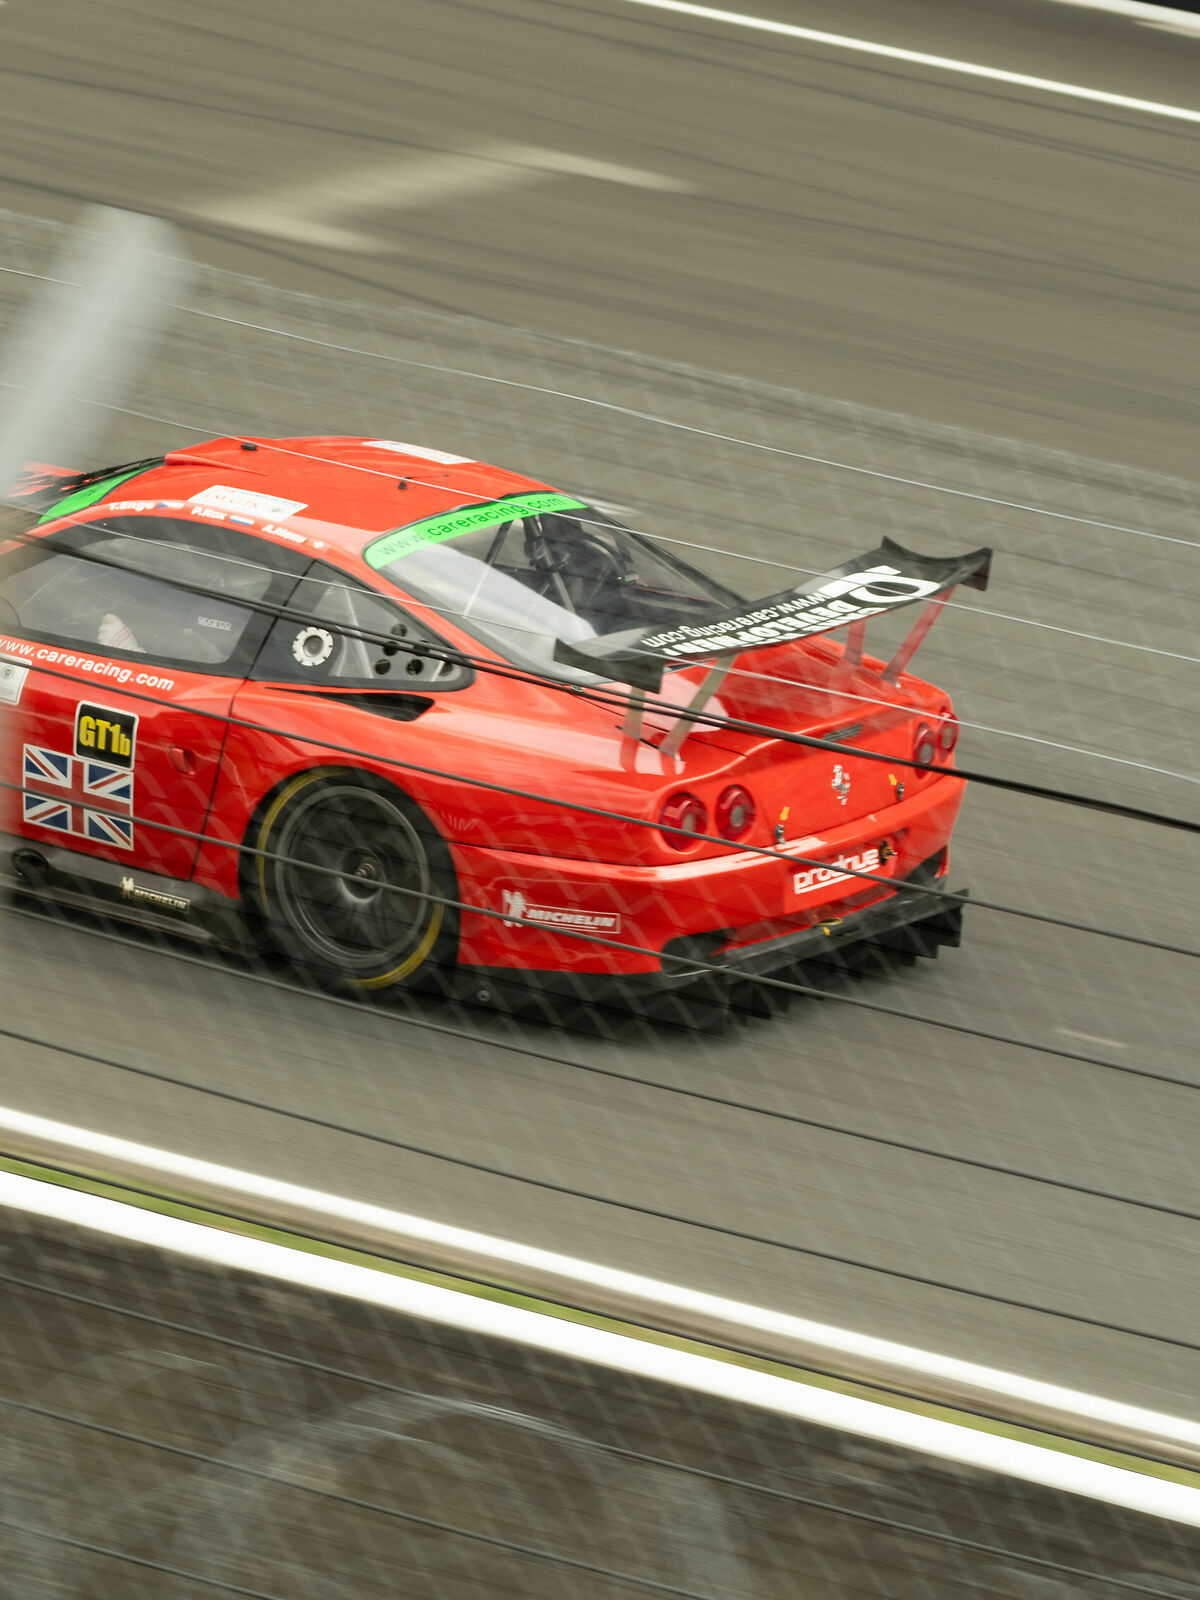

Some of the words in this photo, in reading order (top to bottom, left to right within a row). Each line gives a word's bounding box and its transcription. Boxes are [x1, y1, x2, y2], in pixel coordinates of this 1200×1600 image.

[190, 505, 228, 521] P.Kox
[375, 496, 567, 556] www.careracingcom
[134, 888, 187, 909] MICHELIN
[527, 909, 616, 927] MICHELIN
